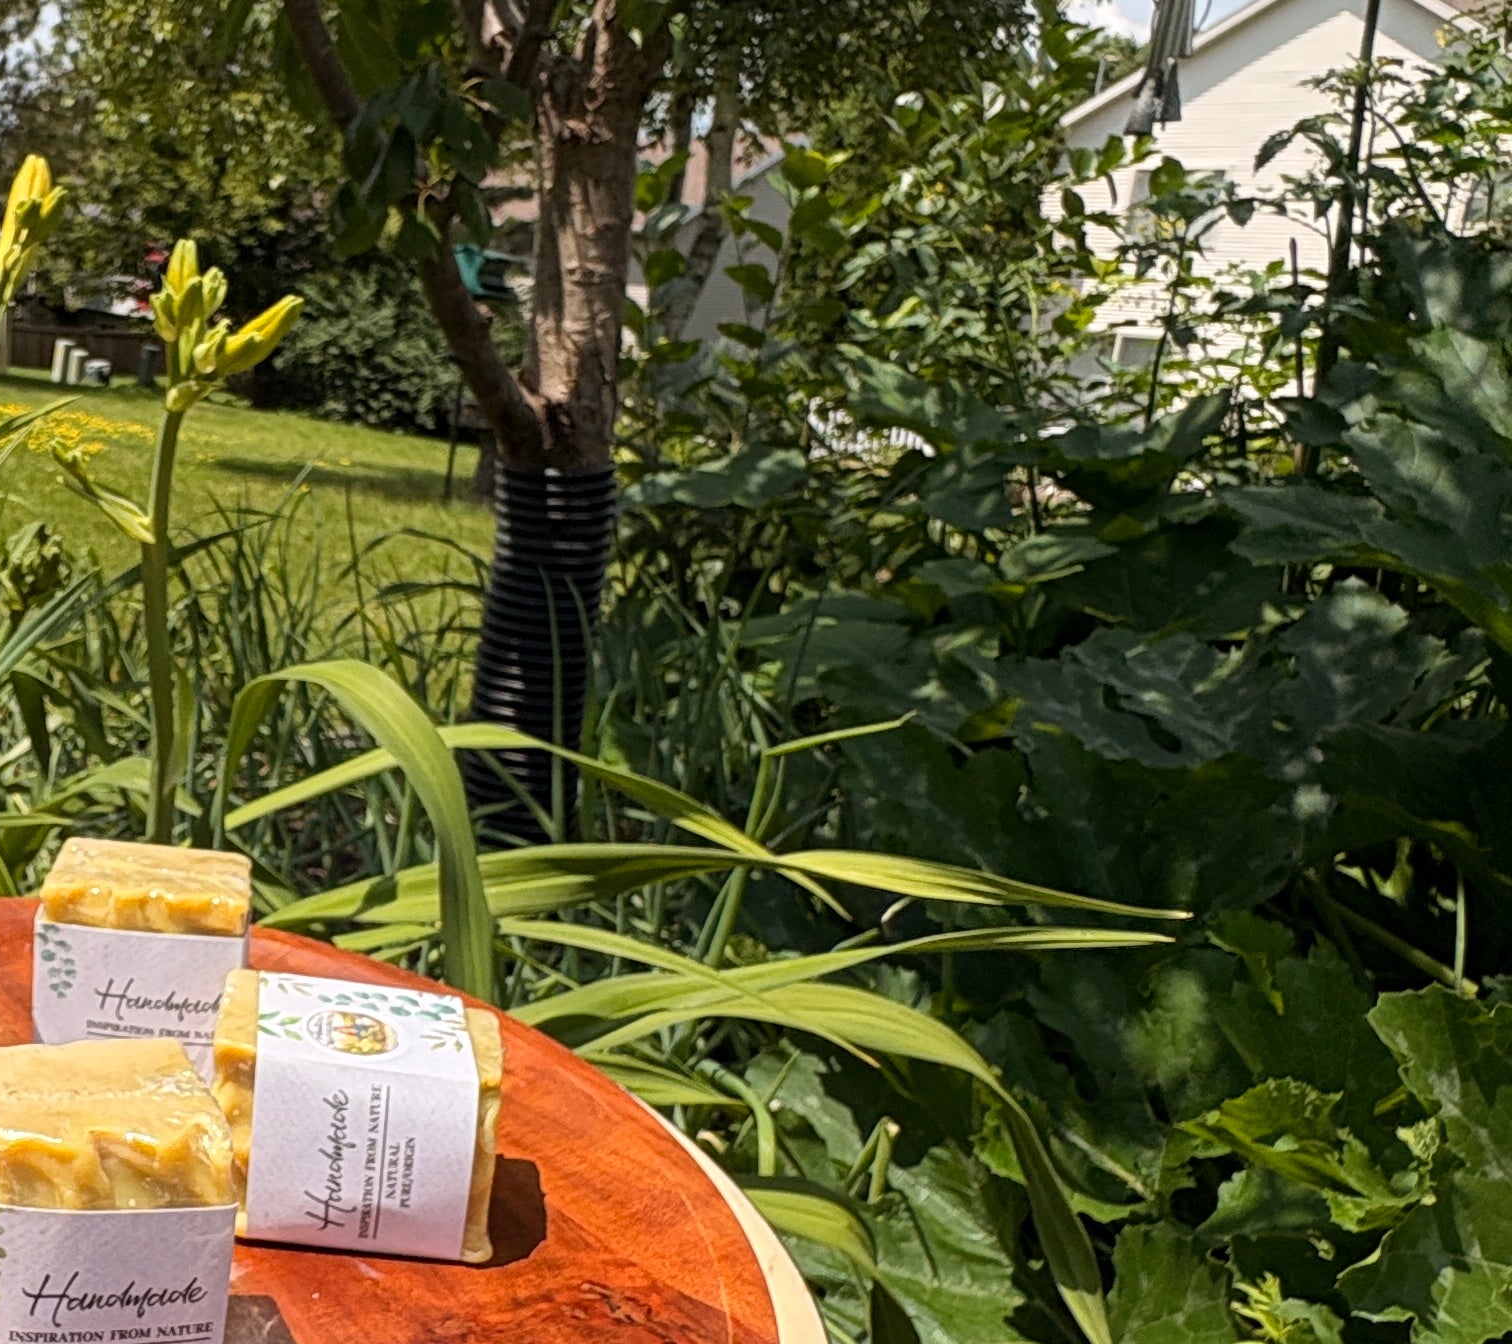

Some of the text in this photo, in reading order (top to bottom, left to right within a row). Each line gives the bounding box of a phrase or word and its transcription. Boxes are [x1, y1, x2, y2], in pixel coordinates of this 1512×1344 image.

[94, 977, 223, 1022] Handmad
[367, 1082, 383, 1134] NATURE
[303, 1088, 357, 1231] Handmade
[364, 1137, 378, 1171] FROM
[385, 1141, 400, 1200] NATURAL
[21, 1270, 208, 1328] Handmade
[8, 1321, 214, 1344] INSPIRATION FROM NATURE
